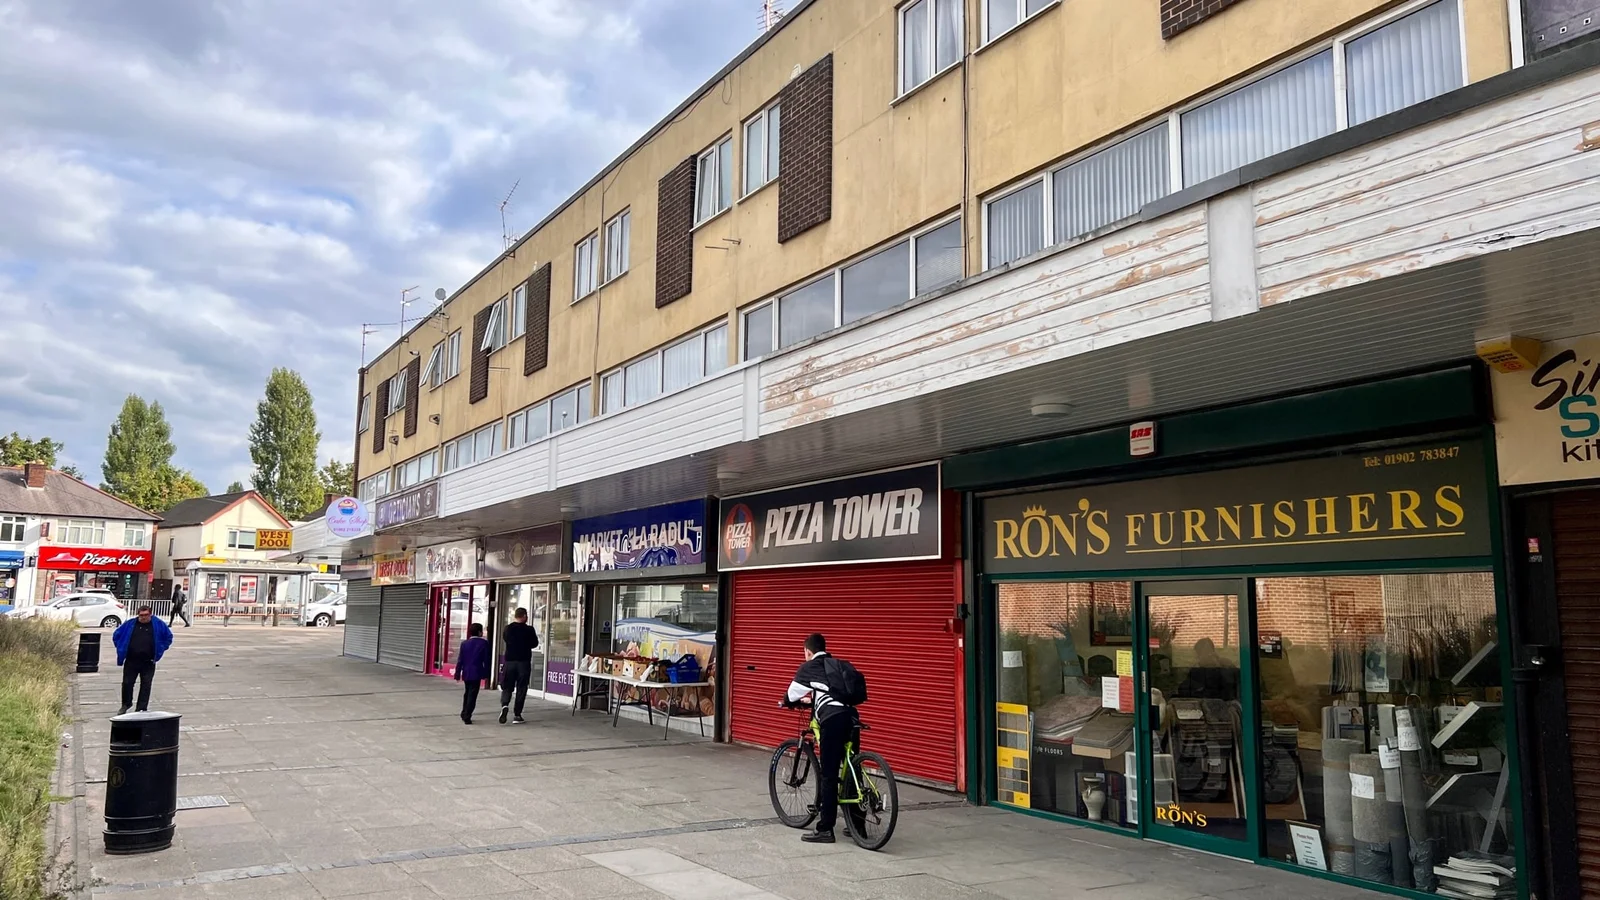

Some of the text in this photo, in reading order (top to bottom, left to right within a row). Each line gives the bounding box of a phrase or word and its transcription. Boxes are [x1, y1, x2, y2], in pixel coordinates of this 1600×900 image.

[1362, 446, 1460, 468] Tel: 01902 783847
[388, 492, 421, 524] OPTICIANS
[349, 515, 368, 527] Shop
[762, 487, 923, 548] PIZZA TOWER
[994, 485, 1465, 559] RON'S FURNISHERS
[259, 530, 291, 539] WEST
[726, 521, 752, 538] PIZZA
[259, 539, 290, 548] POOL
[579, 528, 623, 553] MARKET
[727, 535, 750, 550] TOWER
[80, 552, 145, 566] Pizza Hut
[547, 671, 558, 683] FREE
[558, 672, 567, 685] EYE
[1044, 746, 1064, 756] FLOORS
[1156, 805, 1208, 828] RON'S
